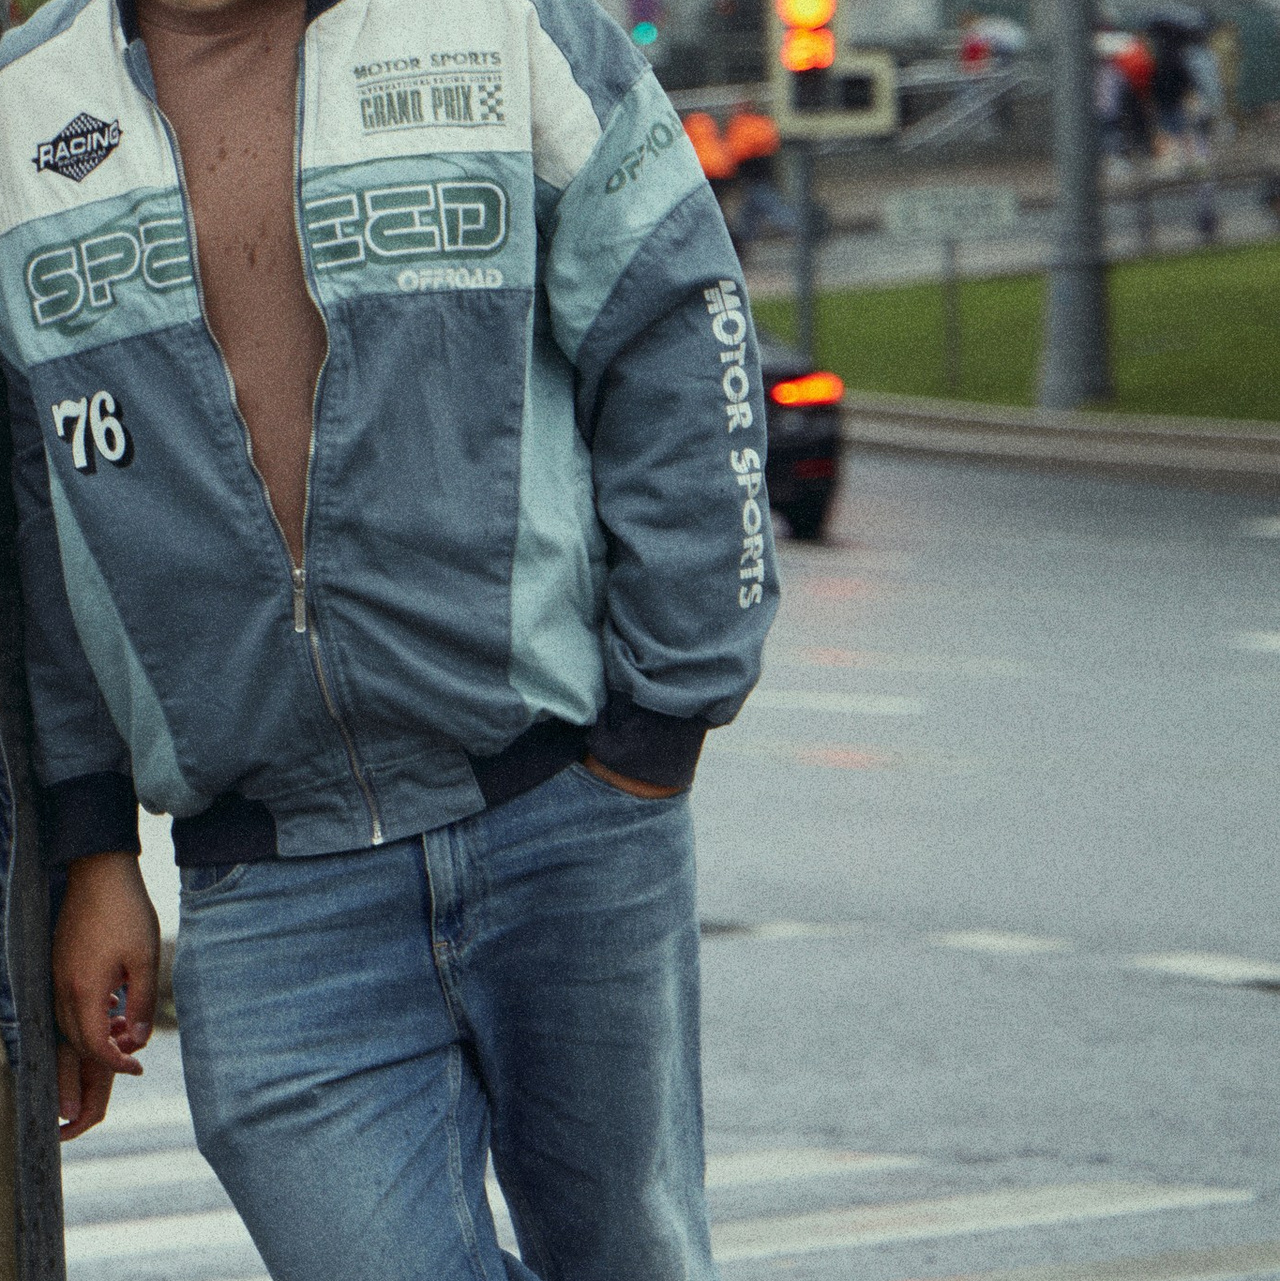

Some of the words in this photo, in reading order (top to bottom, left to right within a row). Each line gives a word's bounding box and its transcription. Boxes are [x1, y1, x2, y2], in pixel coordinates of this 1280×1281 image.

[353, 56, 421, 80] MOTOR
[430, 51, 502, 68] SPORTS
[359, 89, 424, 130] GRAND
[431, 84, 474, 122] PRIX
[38, 120, 120, 170] RACING
[396, 267, 505, 293] OFFROAD
[51, 389, 131, 473] 76
[703, 279, 754, 434] MOTOR
[730, 447, 766, 610] SPORTS
